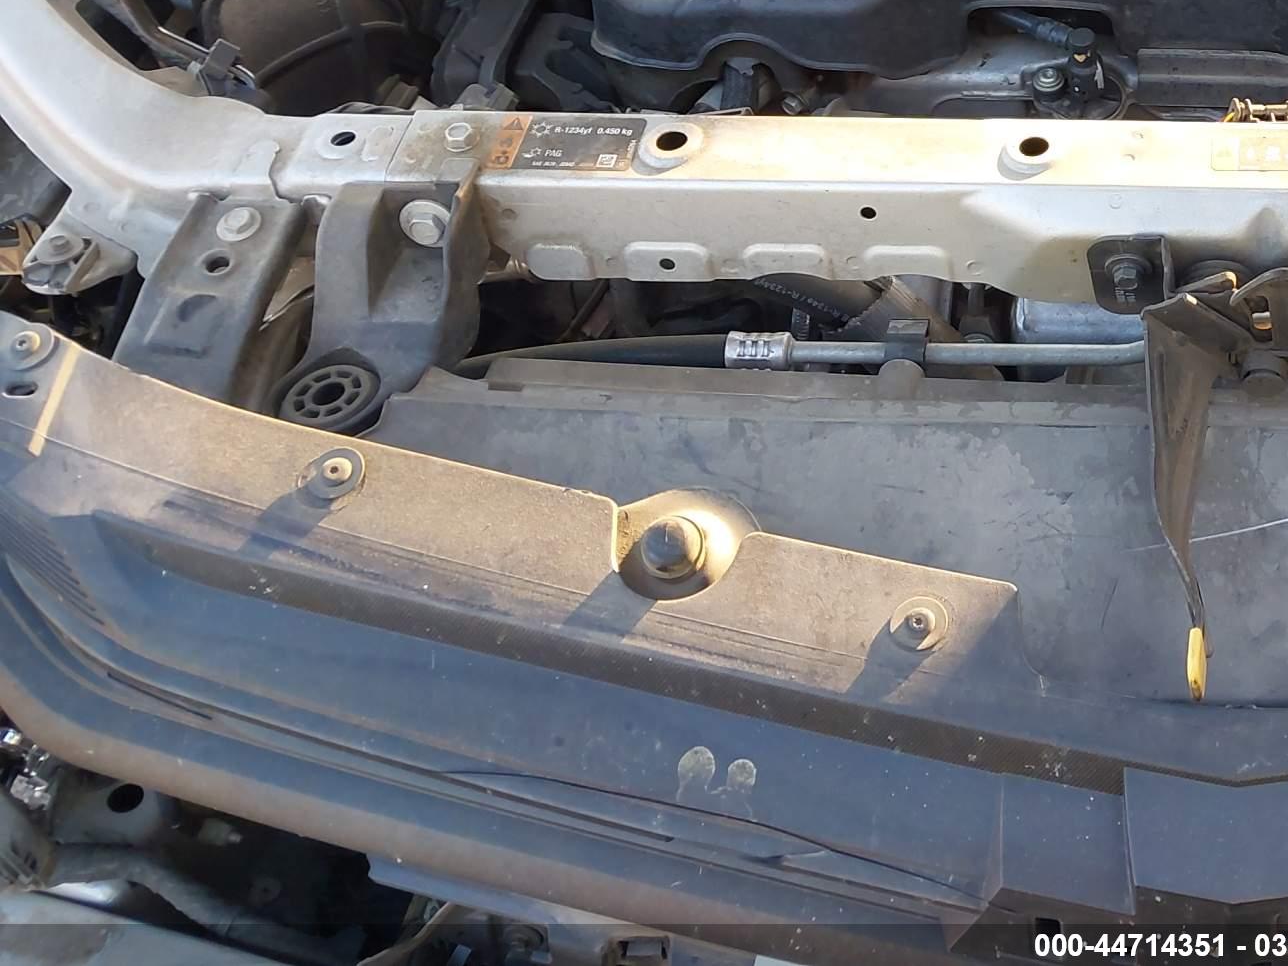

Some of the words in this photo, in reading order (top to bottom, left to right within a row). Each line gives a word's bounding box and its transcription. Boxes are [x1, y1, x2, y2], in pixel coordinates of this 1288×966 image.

[554, 126, 593, 135] R-1234yf
[596, 127, 621, 135] 0.450
[621, 127, 633, 136] kg
[544, 149, 563, 157] PAG
